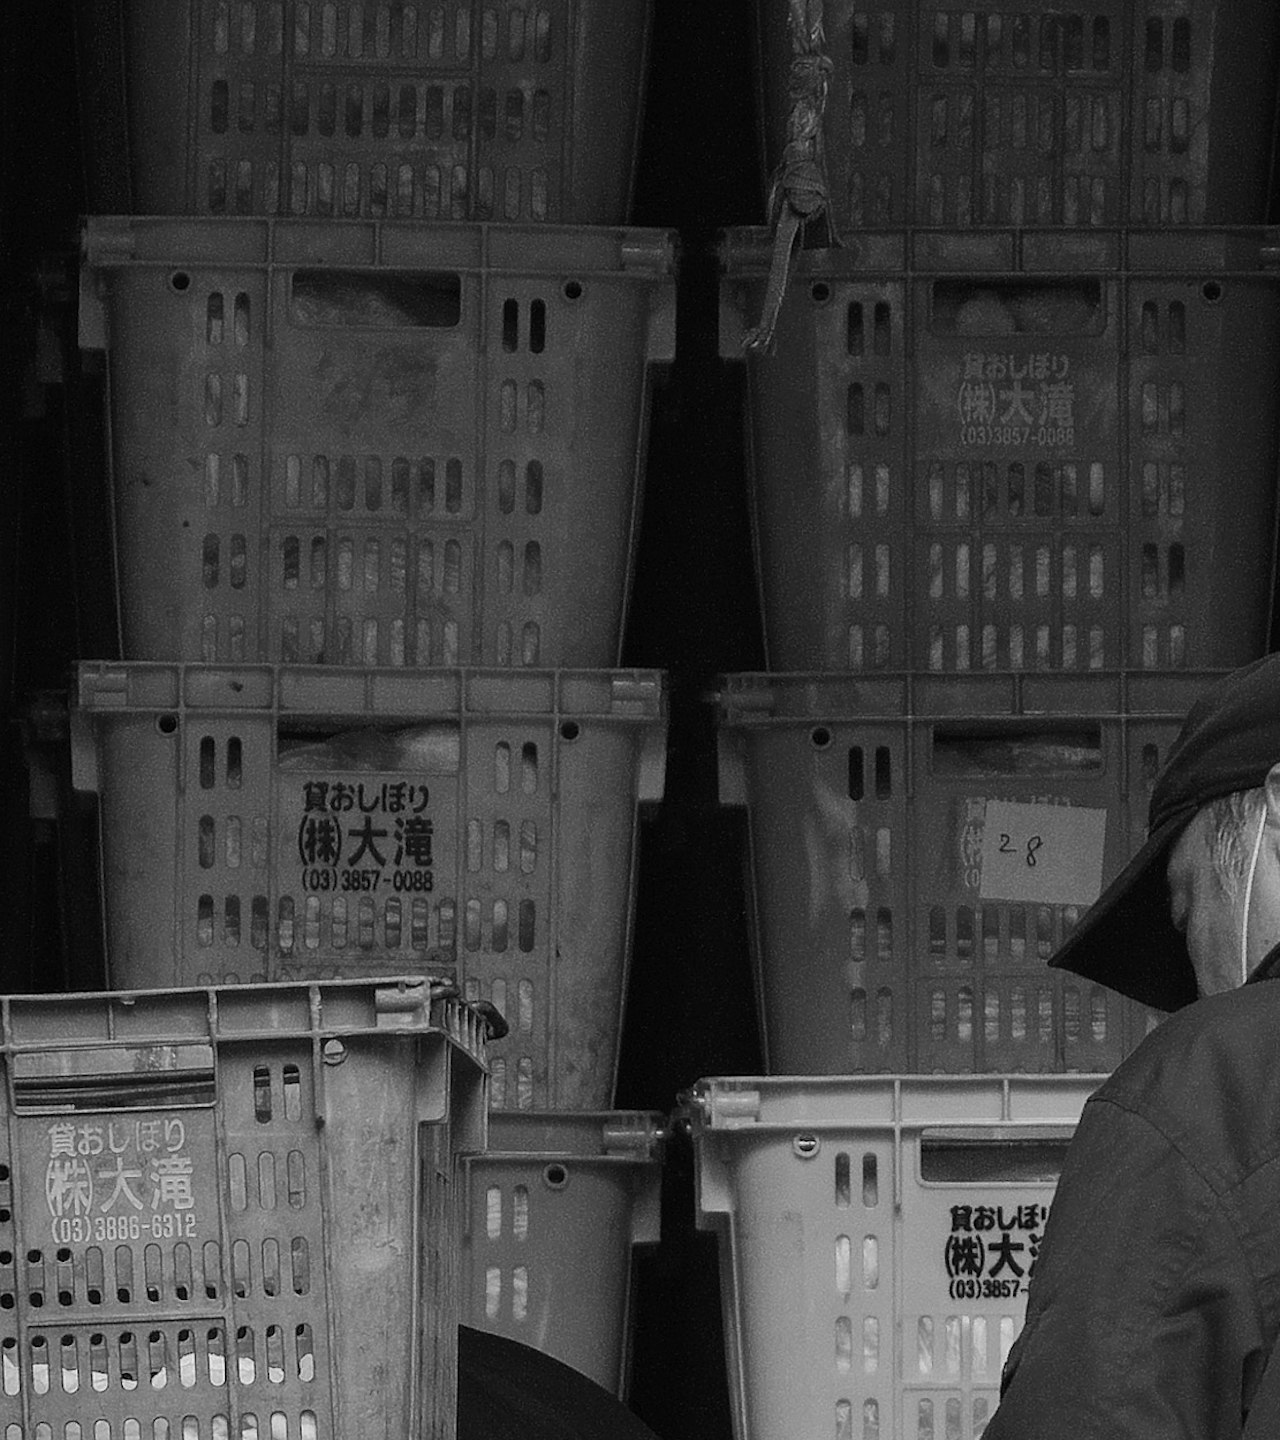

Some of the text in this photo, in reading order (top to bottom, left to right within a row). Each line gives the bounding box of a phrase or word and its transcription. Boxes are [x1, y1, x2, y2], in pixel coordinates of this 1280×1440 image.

[301, 869, 434, 893] (03)3857-0088
[45, 1154, 195, 1217] (株)大滝
[51, 1213, 199, 1244] (03)3886-6312
[949, 1279, 1030, 1300] (03)3857-
